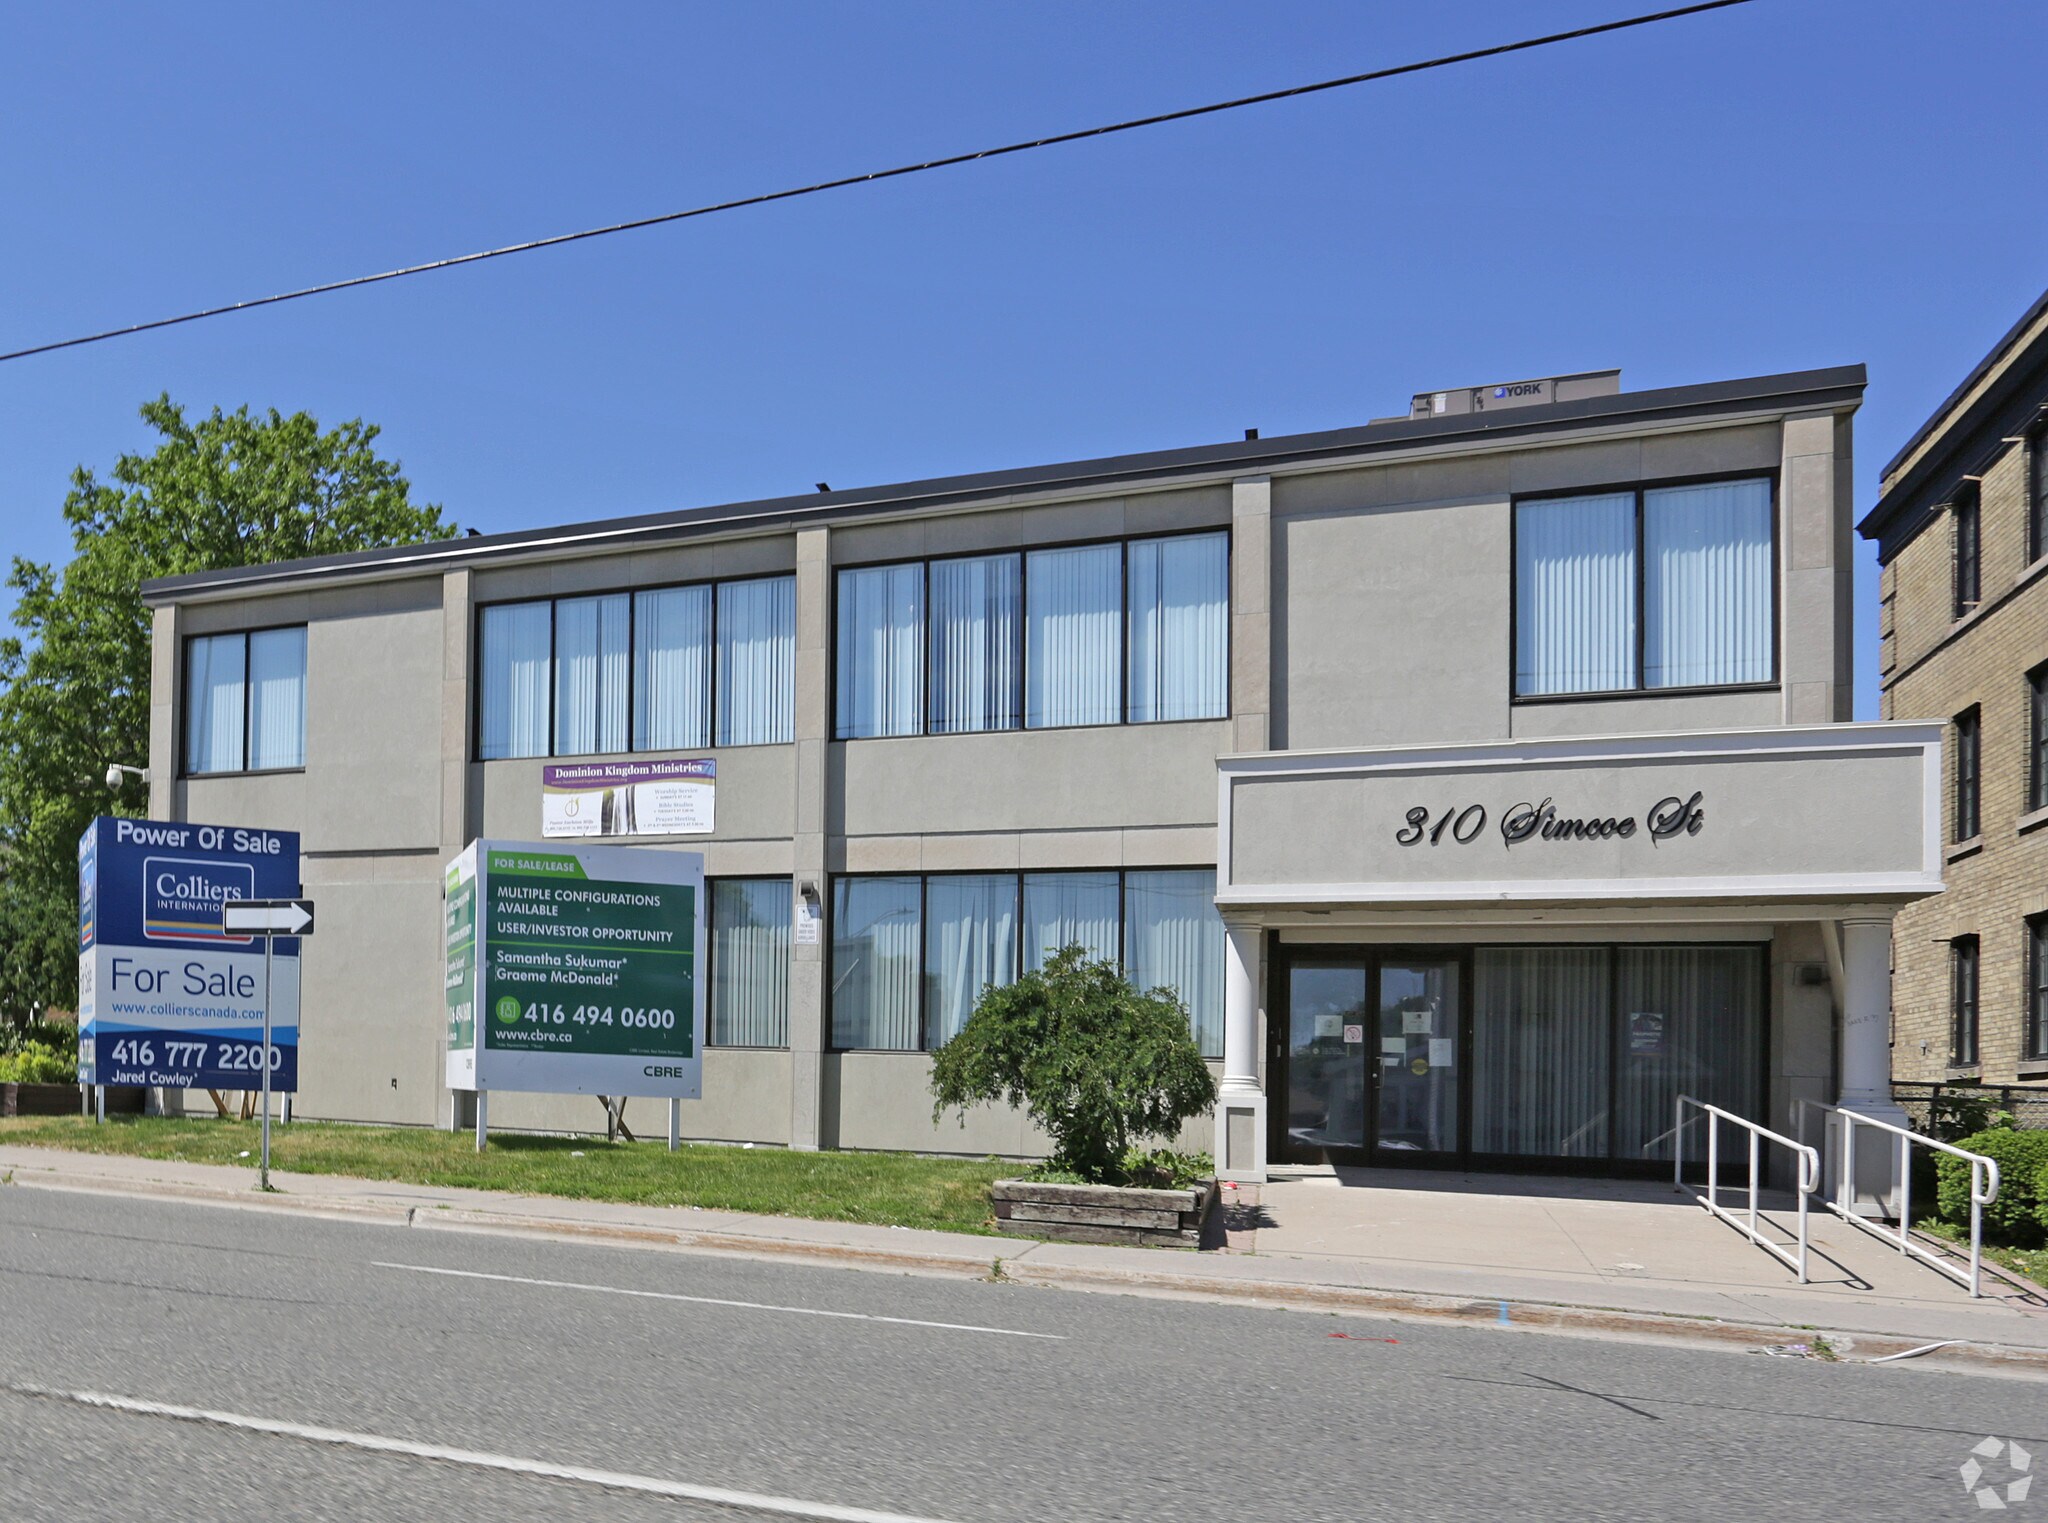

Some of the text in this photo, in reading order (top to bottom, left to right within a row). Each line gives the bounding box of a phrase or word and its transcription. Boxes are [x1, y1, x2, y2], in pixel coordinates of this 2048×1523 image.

[1506, 383, 1541, 397] YORK
[555, 762, 703, 779] Dominion Kingdom Ministries
[1396, 791, 1704, 852] 310 Simcoe St
[117, 820, 189, 848] Power
[199, 826, 225, 850] Of
[233, 832, 281, 854] Sale
[494, 857, 575, 873] FOR SALE/LEASE
[156, 872, 241, 901] Colliers
[497, 886, 661, 907] MULTIPLE CONFIGURATIONS
[157, 899, 224, 912] INTERNATIO
[497, 902, 558, 917] AVAILABLE
[497, 921, 673, 943] USER/INVESTOR OPPORTUNITY
[496, 950, 561, 966] Samantha
[112, 958, 170, 994] For
[183, 962, 255, 998] Sale
[496, 967, 547, 982] Graeme
[112, 1003, 265, 1020] www.collierscanada.com
[524, 1002, 675, 1029] 416 494 0600
[495, 1029, 572, 1042] www.cbre.ca
[111, 1039, 155, 1066] 416
[165, 1041, 208, 1068] 777
[218, 1043, 282, 1071] 2200
[111, 1069, 146, 1083] Jared
[643, 1065, 683, 1078] CBRE
